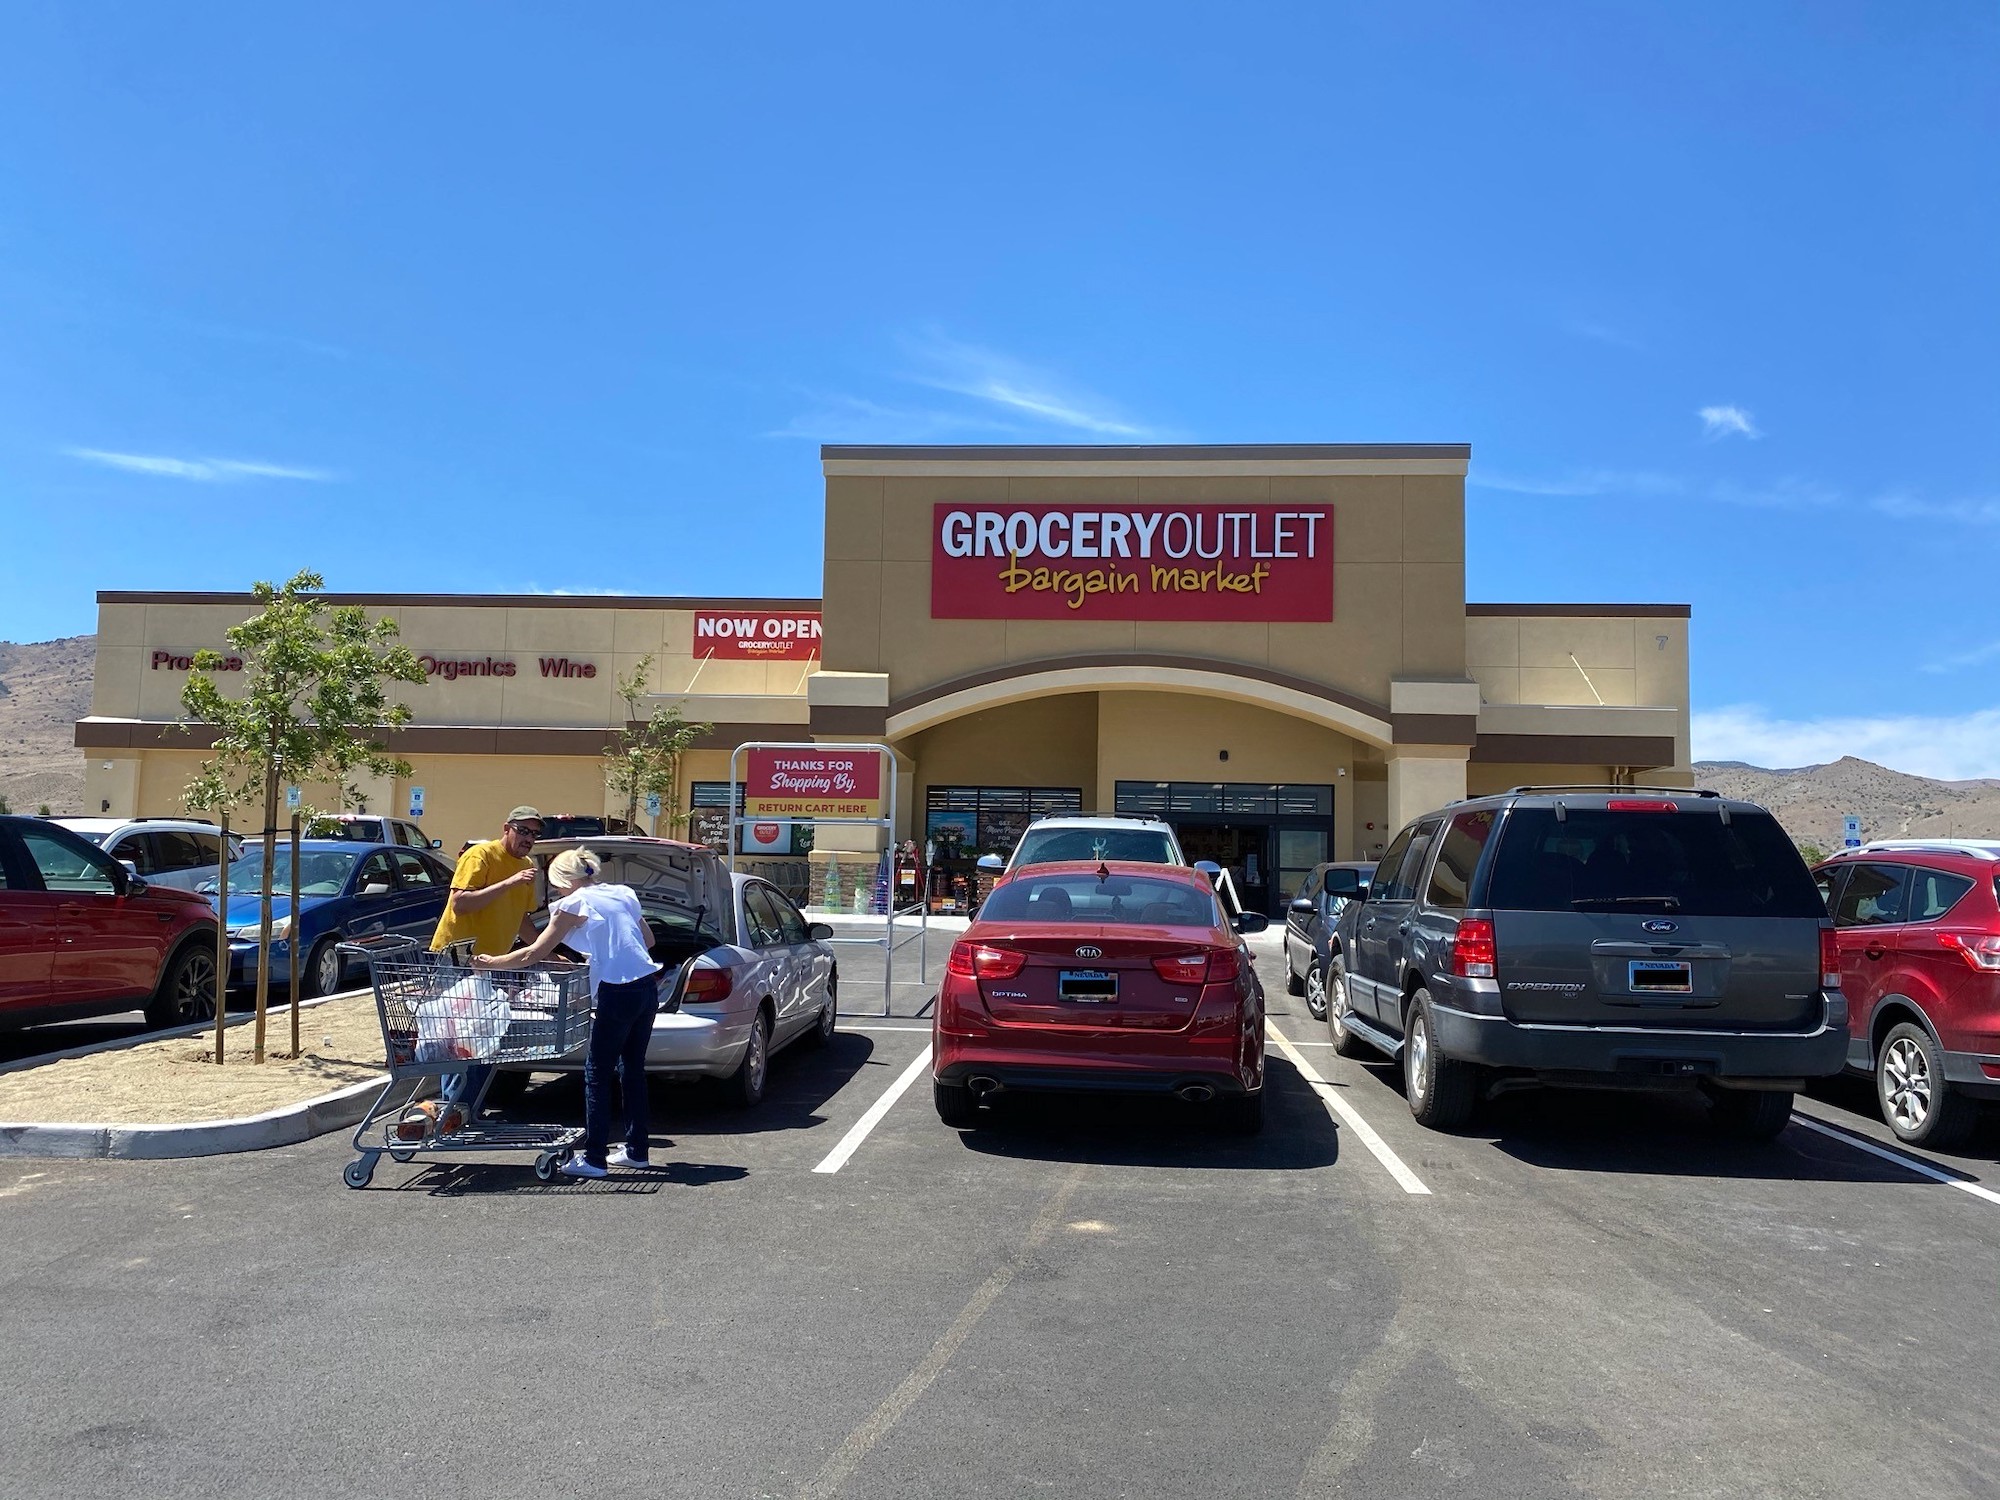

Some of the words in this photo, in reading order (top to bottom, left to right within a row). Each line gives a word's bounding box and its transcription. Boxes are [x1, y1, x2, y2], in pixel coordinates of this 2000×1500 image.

[999, 548, 1140, 609] bargain
[1149, 560, 1270, 594] market
[697, 618, 759, 638] NOW
[762, 619, 823, 639] OPEN
[416, 655, 516, 680] Organics
[538, 657, 597, 678] Wine
[774, 760, 825, 771] THANKS
[828, 761, 854, 771] FOR
[770, 772, 831, 793] Shopping
[833, 773, 857, 794] By.
[758, 803, 802, 812] RETURN
[805, 804, 836, 813] CART
[838, 804, 867, 813] HERE
[1650, 921, 1671, 931] Ford
[1079, 948, 1098, 957] KIA
[1506, 982, 1586, 991] EXPEDITION
